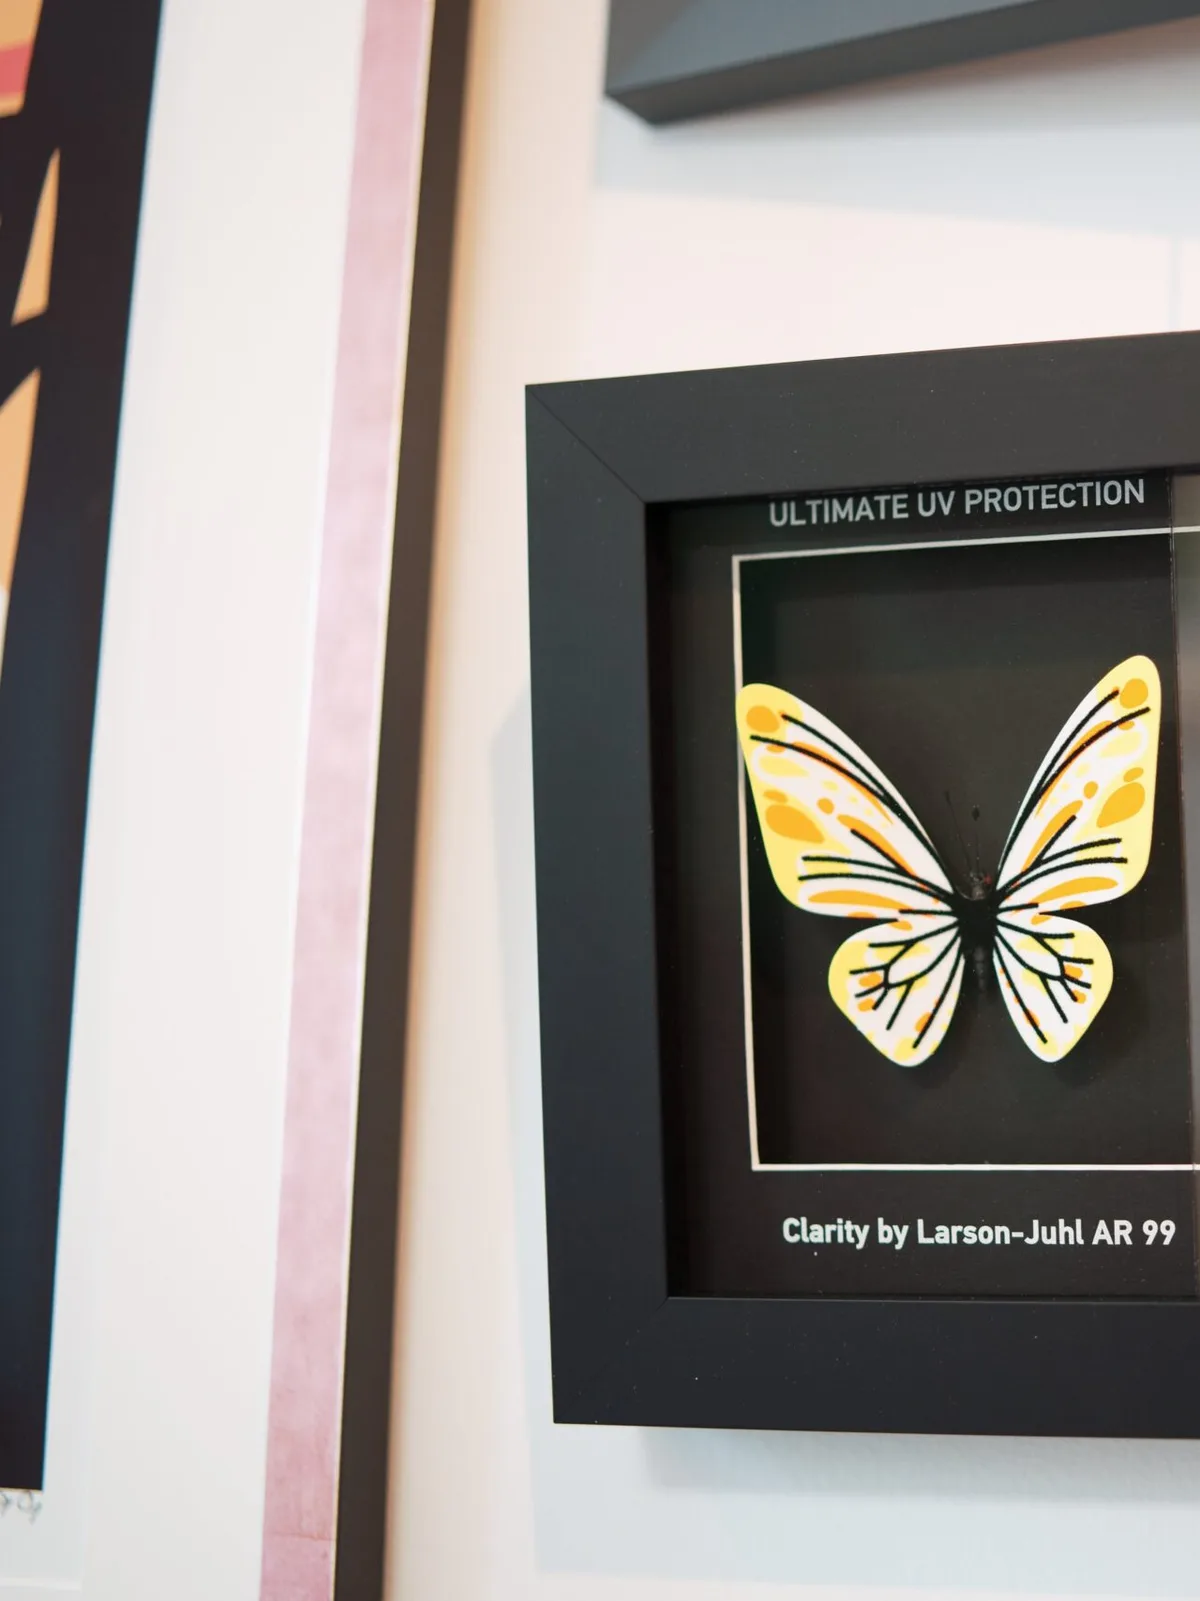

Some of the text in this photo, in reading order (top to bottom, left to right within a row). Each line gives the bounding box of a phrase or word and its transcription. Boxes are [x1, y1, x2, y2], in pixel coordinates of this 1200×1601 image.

[768, 478, 1146, 527] ULTIMATE UV PROTECTION
[782, 1216, 1177, 1250] Clarity by Larson-Juhl AR 99
